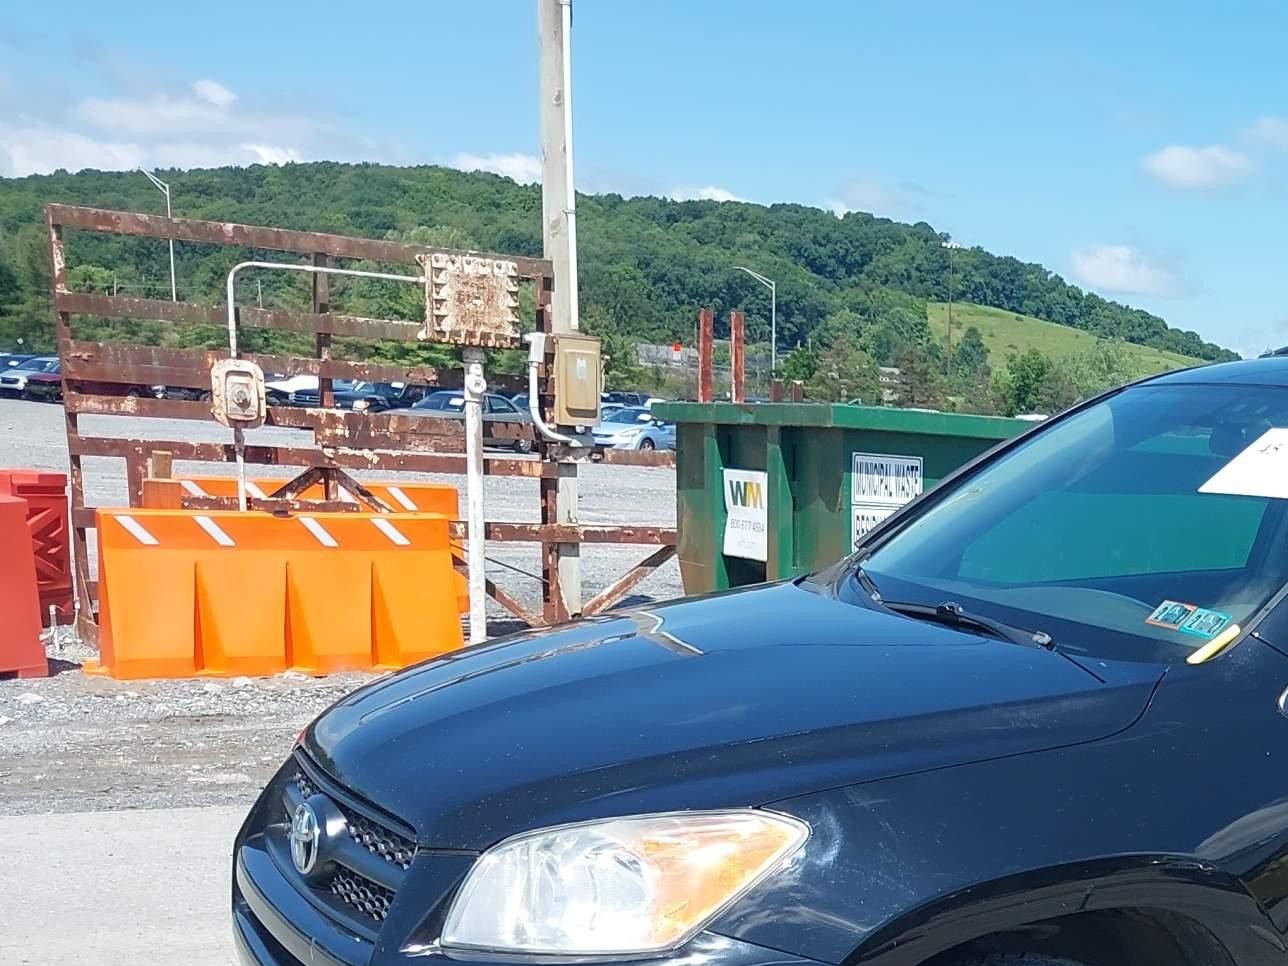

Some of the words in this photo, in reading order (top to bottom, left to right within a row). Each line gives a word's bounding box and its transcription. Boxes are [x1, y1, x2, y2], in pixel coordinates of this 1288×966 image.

[729, 479, 764, 510] WM
[856, 461, 893, 497] MUNICIPAL
[894, 463, 919, 499] WASTE
